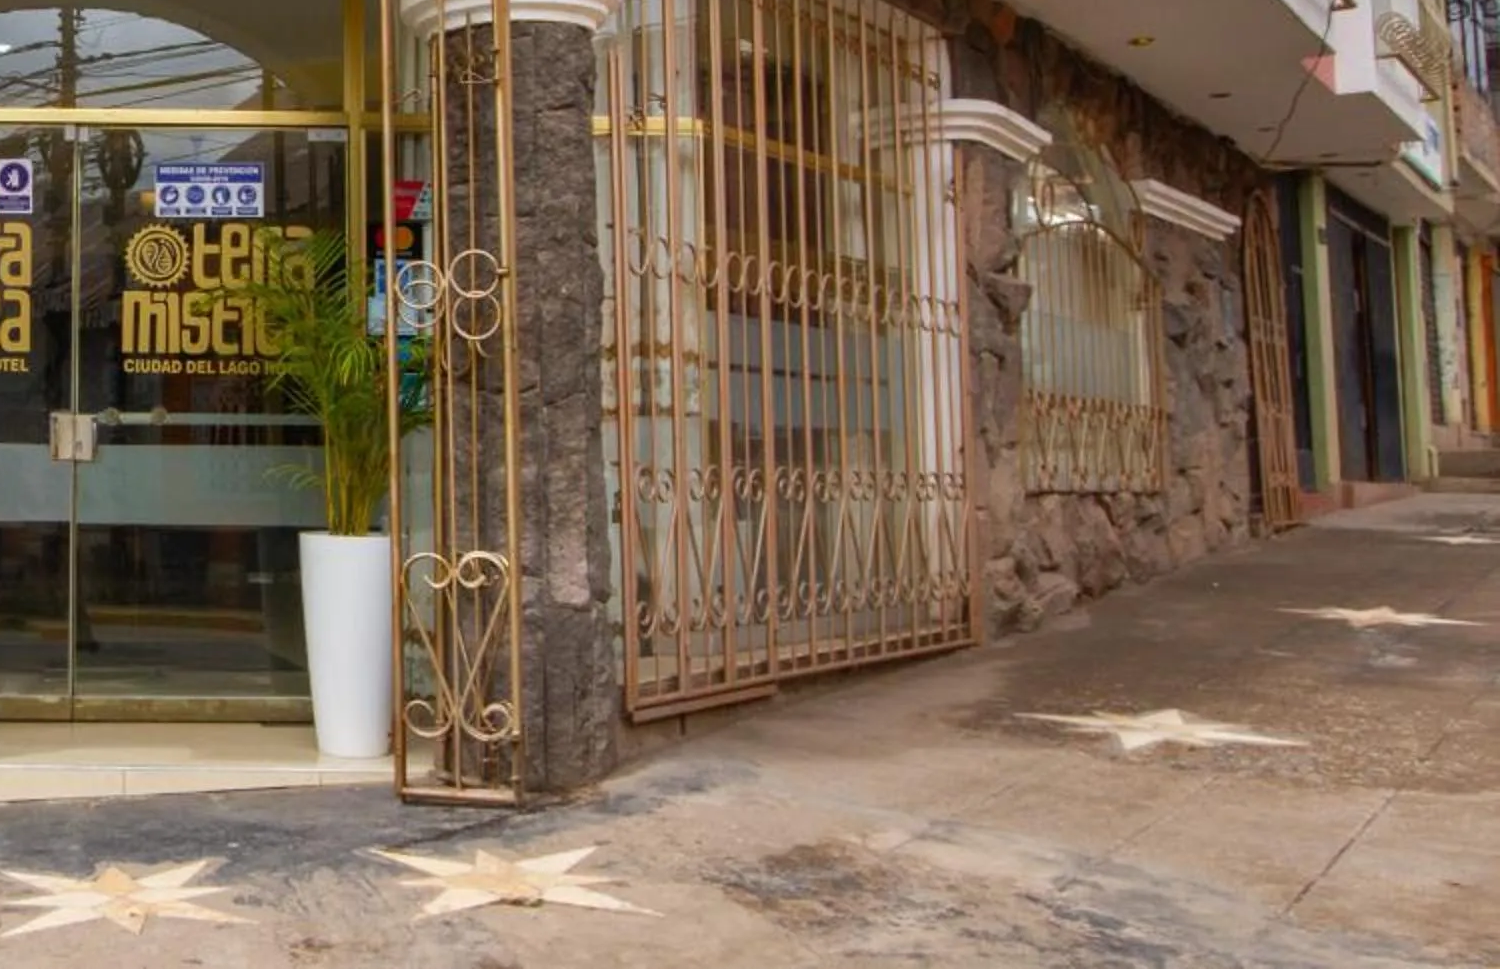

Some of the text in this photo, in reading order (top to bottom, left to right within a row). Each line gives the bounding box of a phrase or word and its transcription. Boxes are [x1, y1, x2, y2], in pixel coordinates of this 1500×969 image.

[121, 289, 316, 356] mistic
[123, 359, 183, 374] CIUDAD
[186, 360, 216, 374] DEL
[219, 360, 261, 375] LAGO
